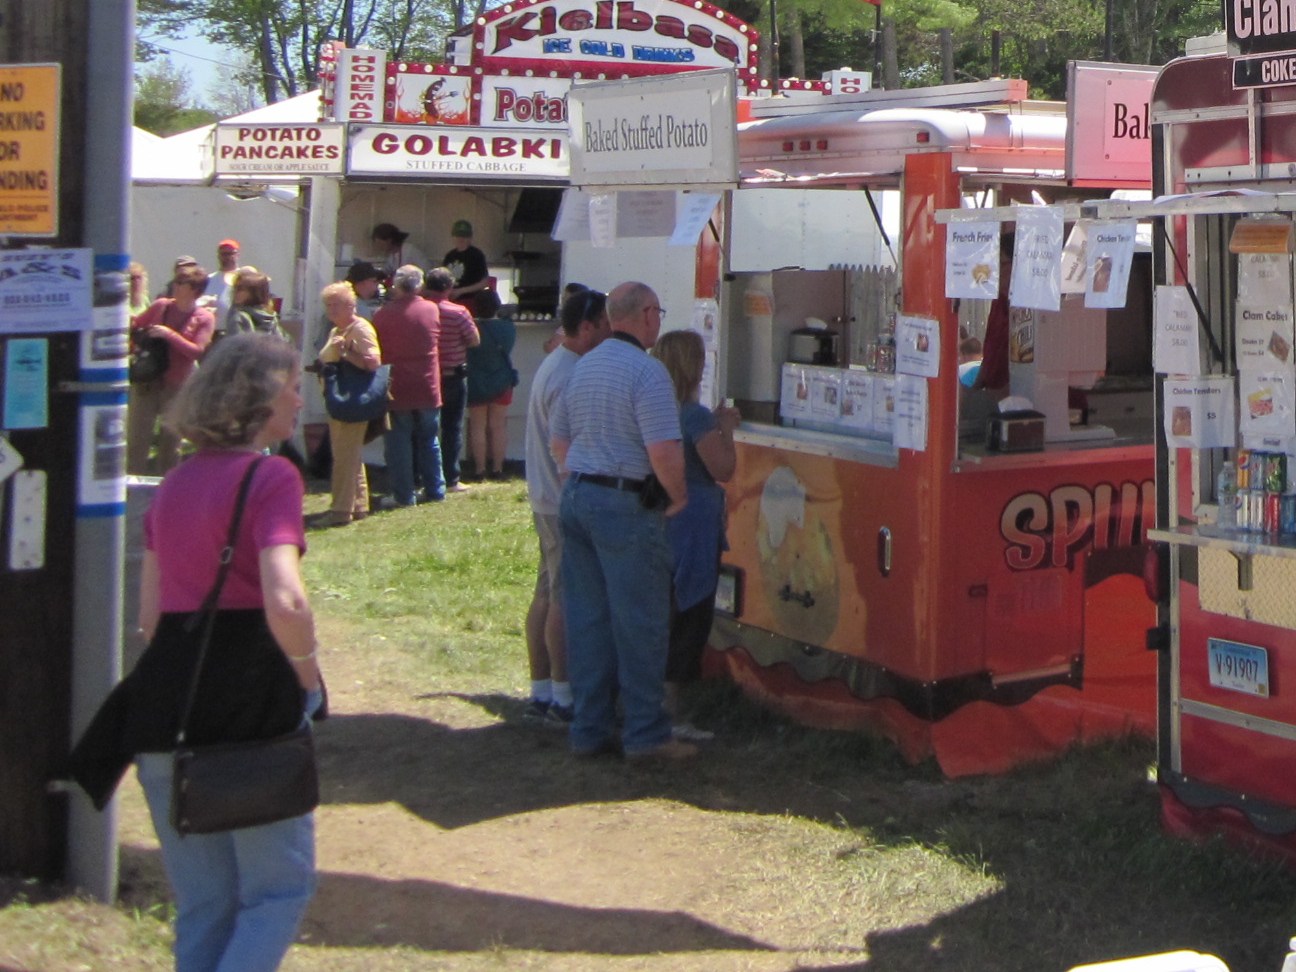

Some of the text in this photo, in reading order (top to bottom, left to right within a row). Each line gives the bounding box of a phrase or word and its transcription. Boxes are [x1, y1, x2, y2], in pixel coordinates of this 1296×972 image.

[490, 0, 740, 64] Kielbasa
[543, 38, 695, 62] ICE COLD DRINKS
[0, 82, 24, 101] NO
[349, 55, 376, 122] HOMEMAD
[494, 87, 569, 123] Pota
[238, 128, 322, 141] POTATO
[585, 115, 708, 153] Baked Stuffed Potato
[221, 145, 339, 159] PANCAKES
[371, 133, 561, 159] GOLABKI
[406, 160, 526, 172] STUFFED CABBAGE
[952, 231, 975, 242] French
[1243, 310, 1264, 321] Clam
[1207, 412, 1216, 420] $5
